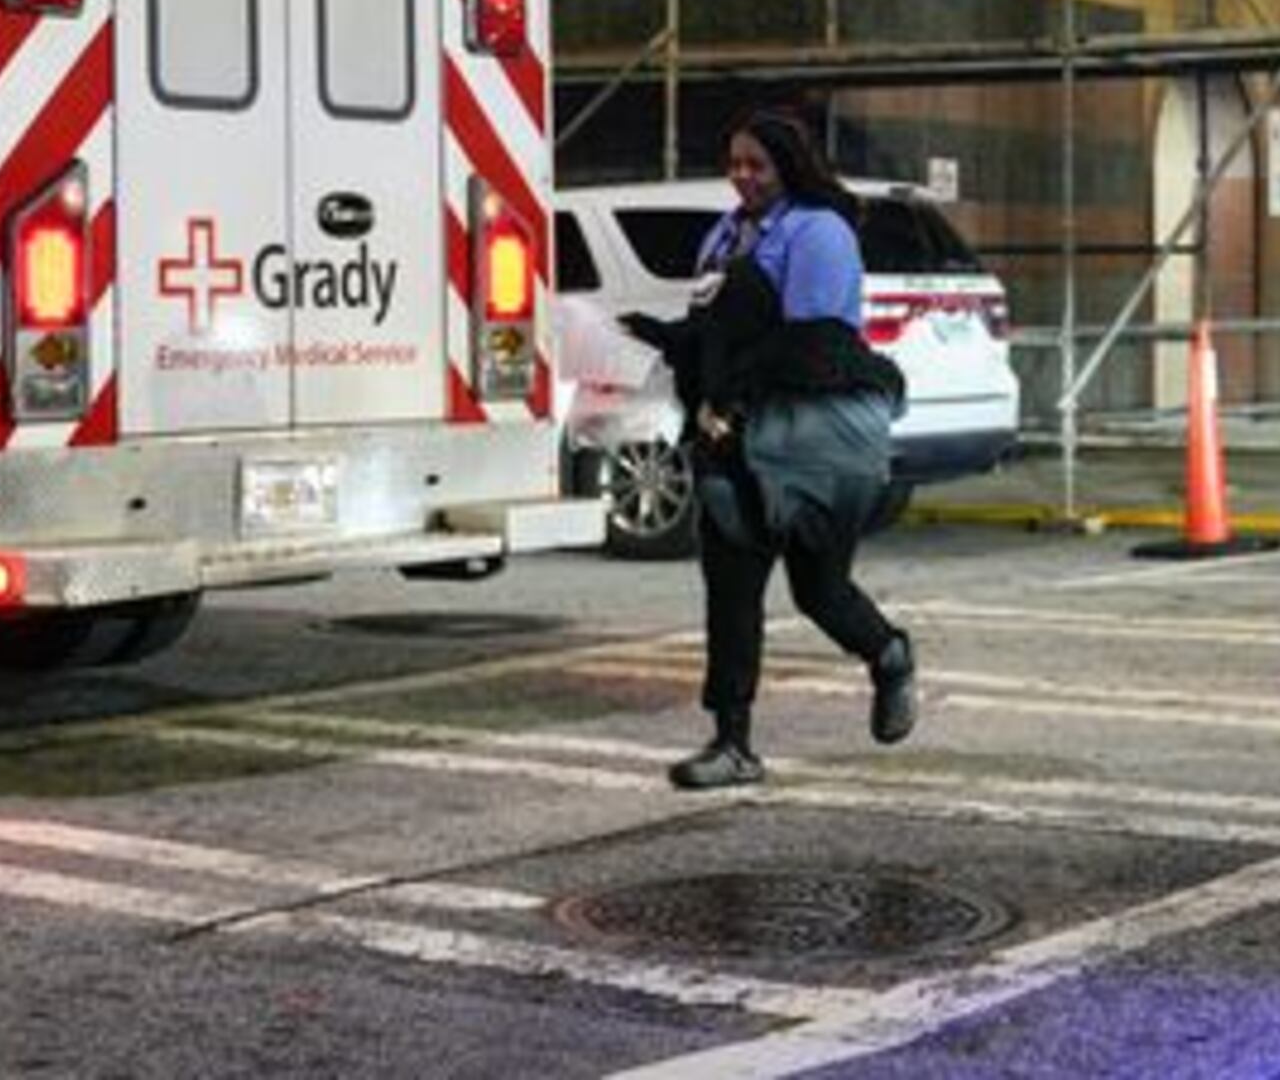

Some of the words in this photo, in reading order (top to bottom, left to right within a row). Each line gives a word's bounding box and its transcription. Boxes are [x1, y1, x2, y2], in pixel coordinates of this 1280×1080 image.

[252, 240, 398, 326] Grady
[156, 344, 269, 371] Emergency
[274, 339, 349, 367] Medical
[352, 341, 416, 362] Service
